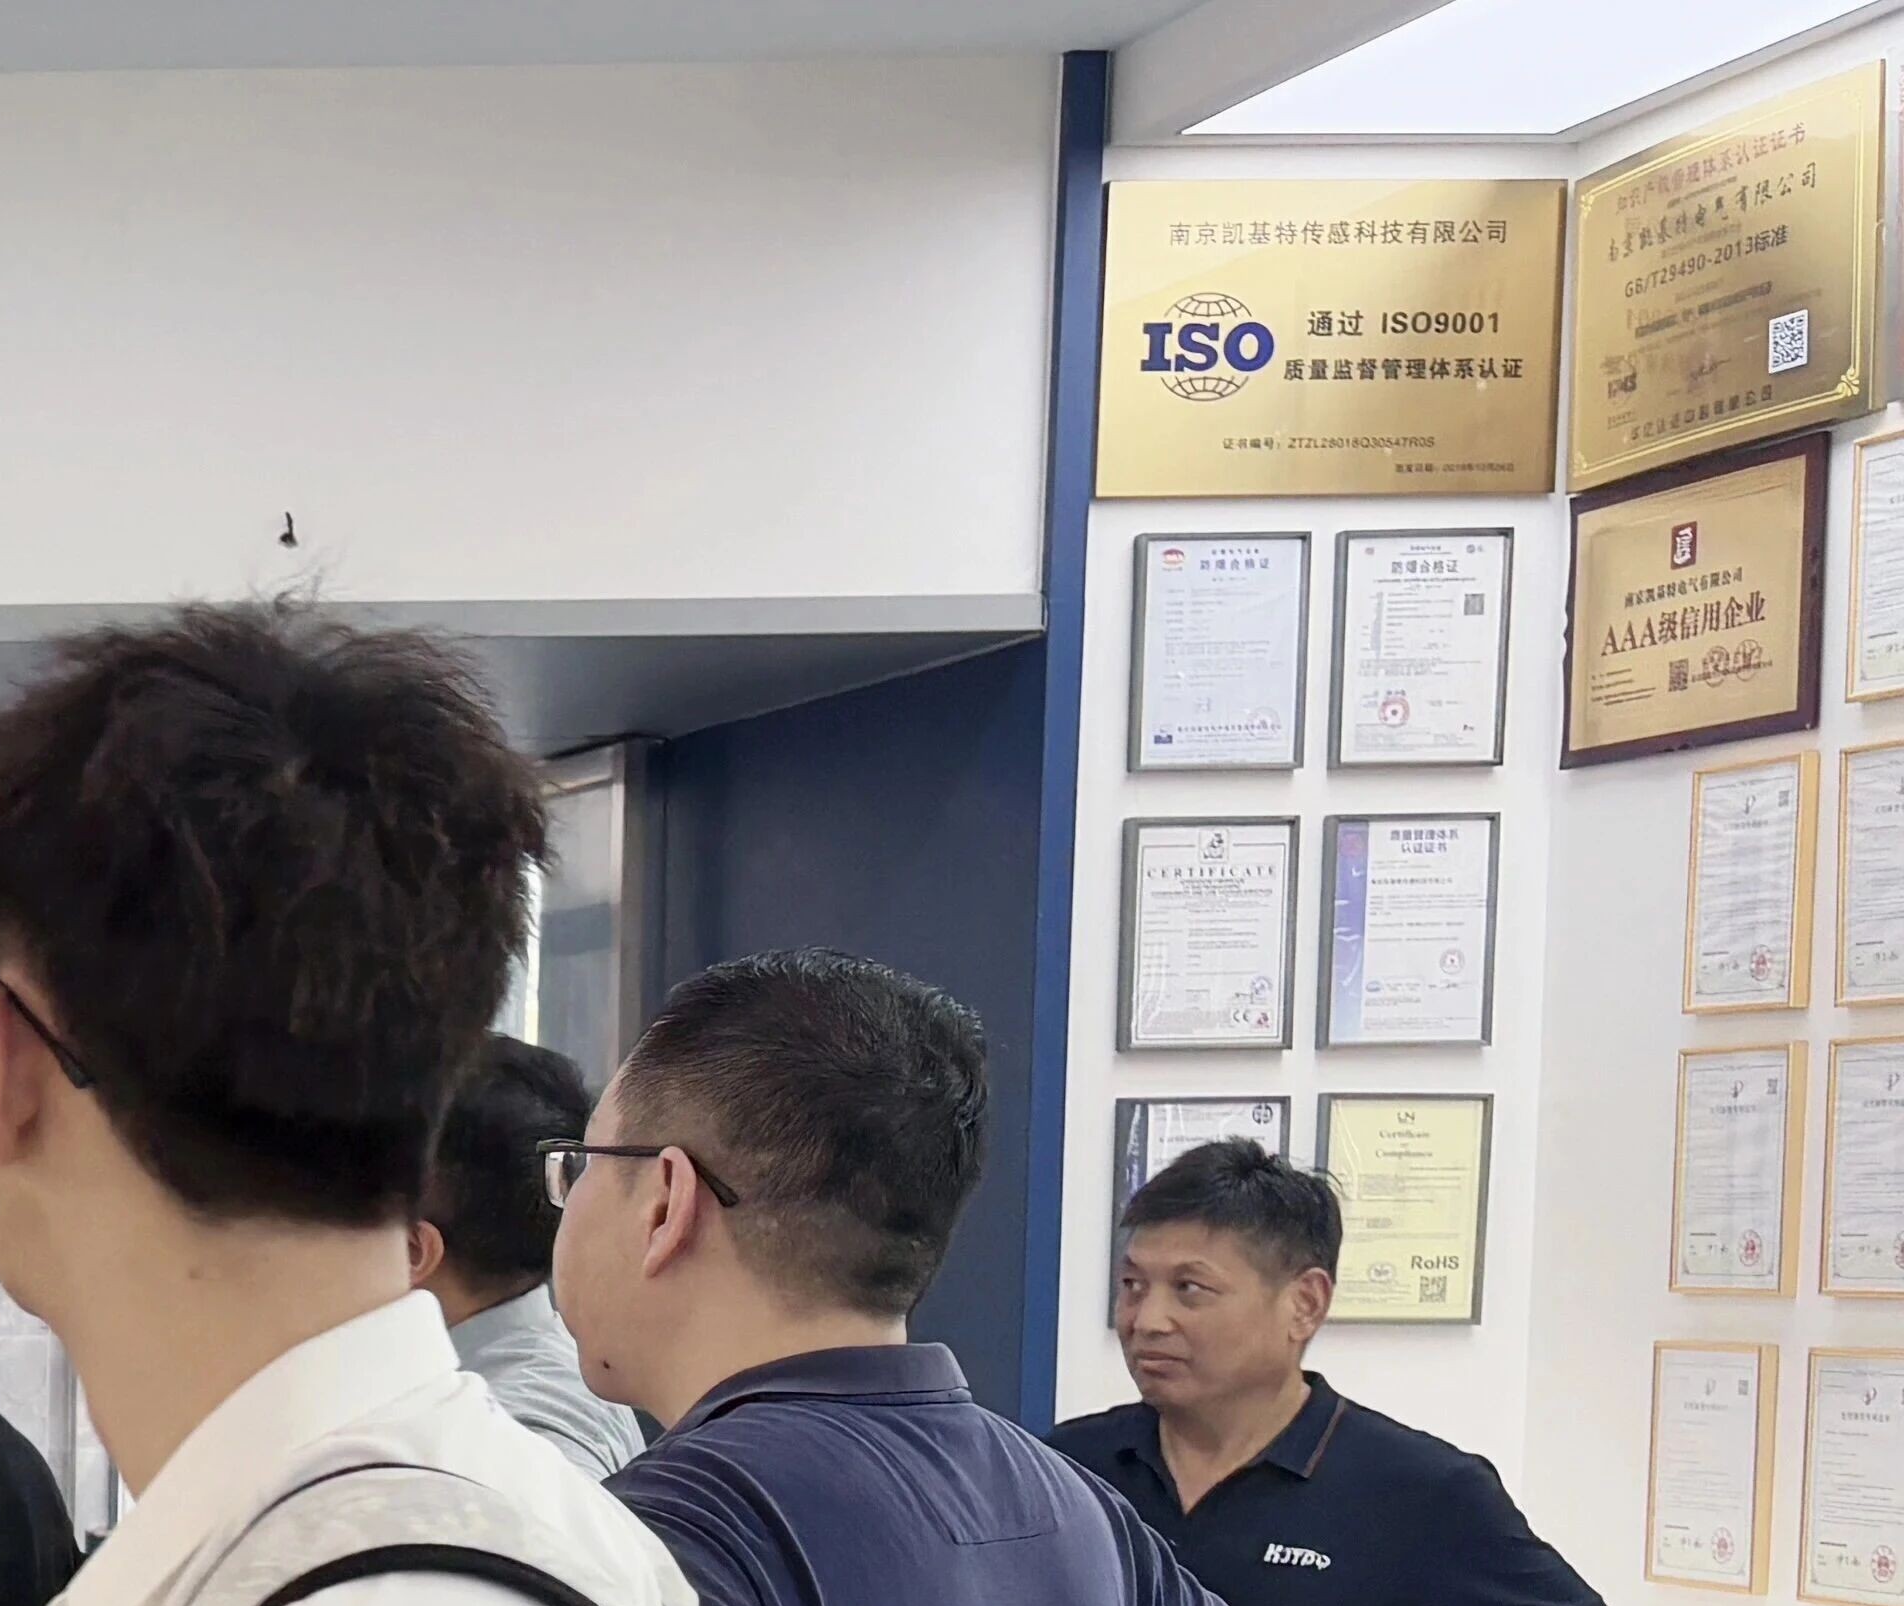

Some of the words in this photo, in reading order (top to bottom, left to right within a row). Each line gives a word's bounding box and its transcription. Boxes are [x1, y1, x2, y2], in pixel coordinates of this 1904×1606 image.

[1168, 219, 1508, 247] 南京凯基特传感科技有限公司
[1307, 310, 1365, 338] 通过
[1381, 311, 1500, 336] ISO9001
[1140, 321, 1275, 374] ISO
[1283, 357, 1524, 382] 质量监督管理体系认证
[1600, 590, 1766, 656] AAA级信用企业
[1410, 1255, 1460, 1271] RoHS
